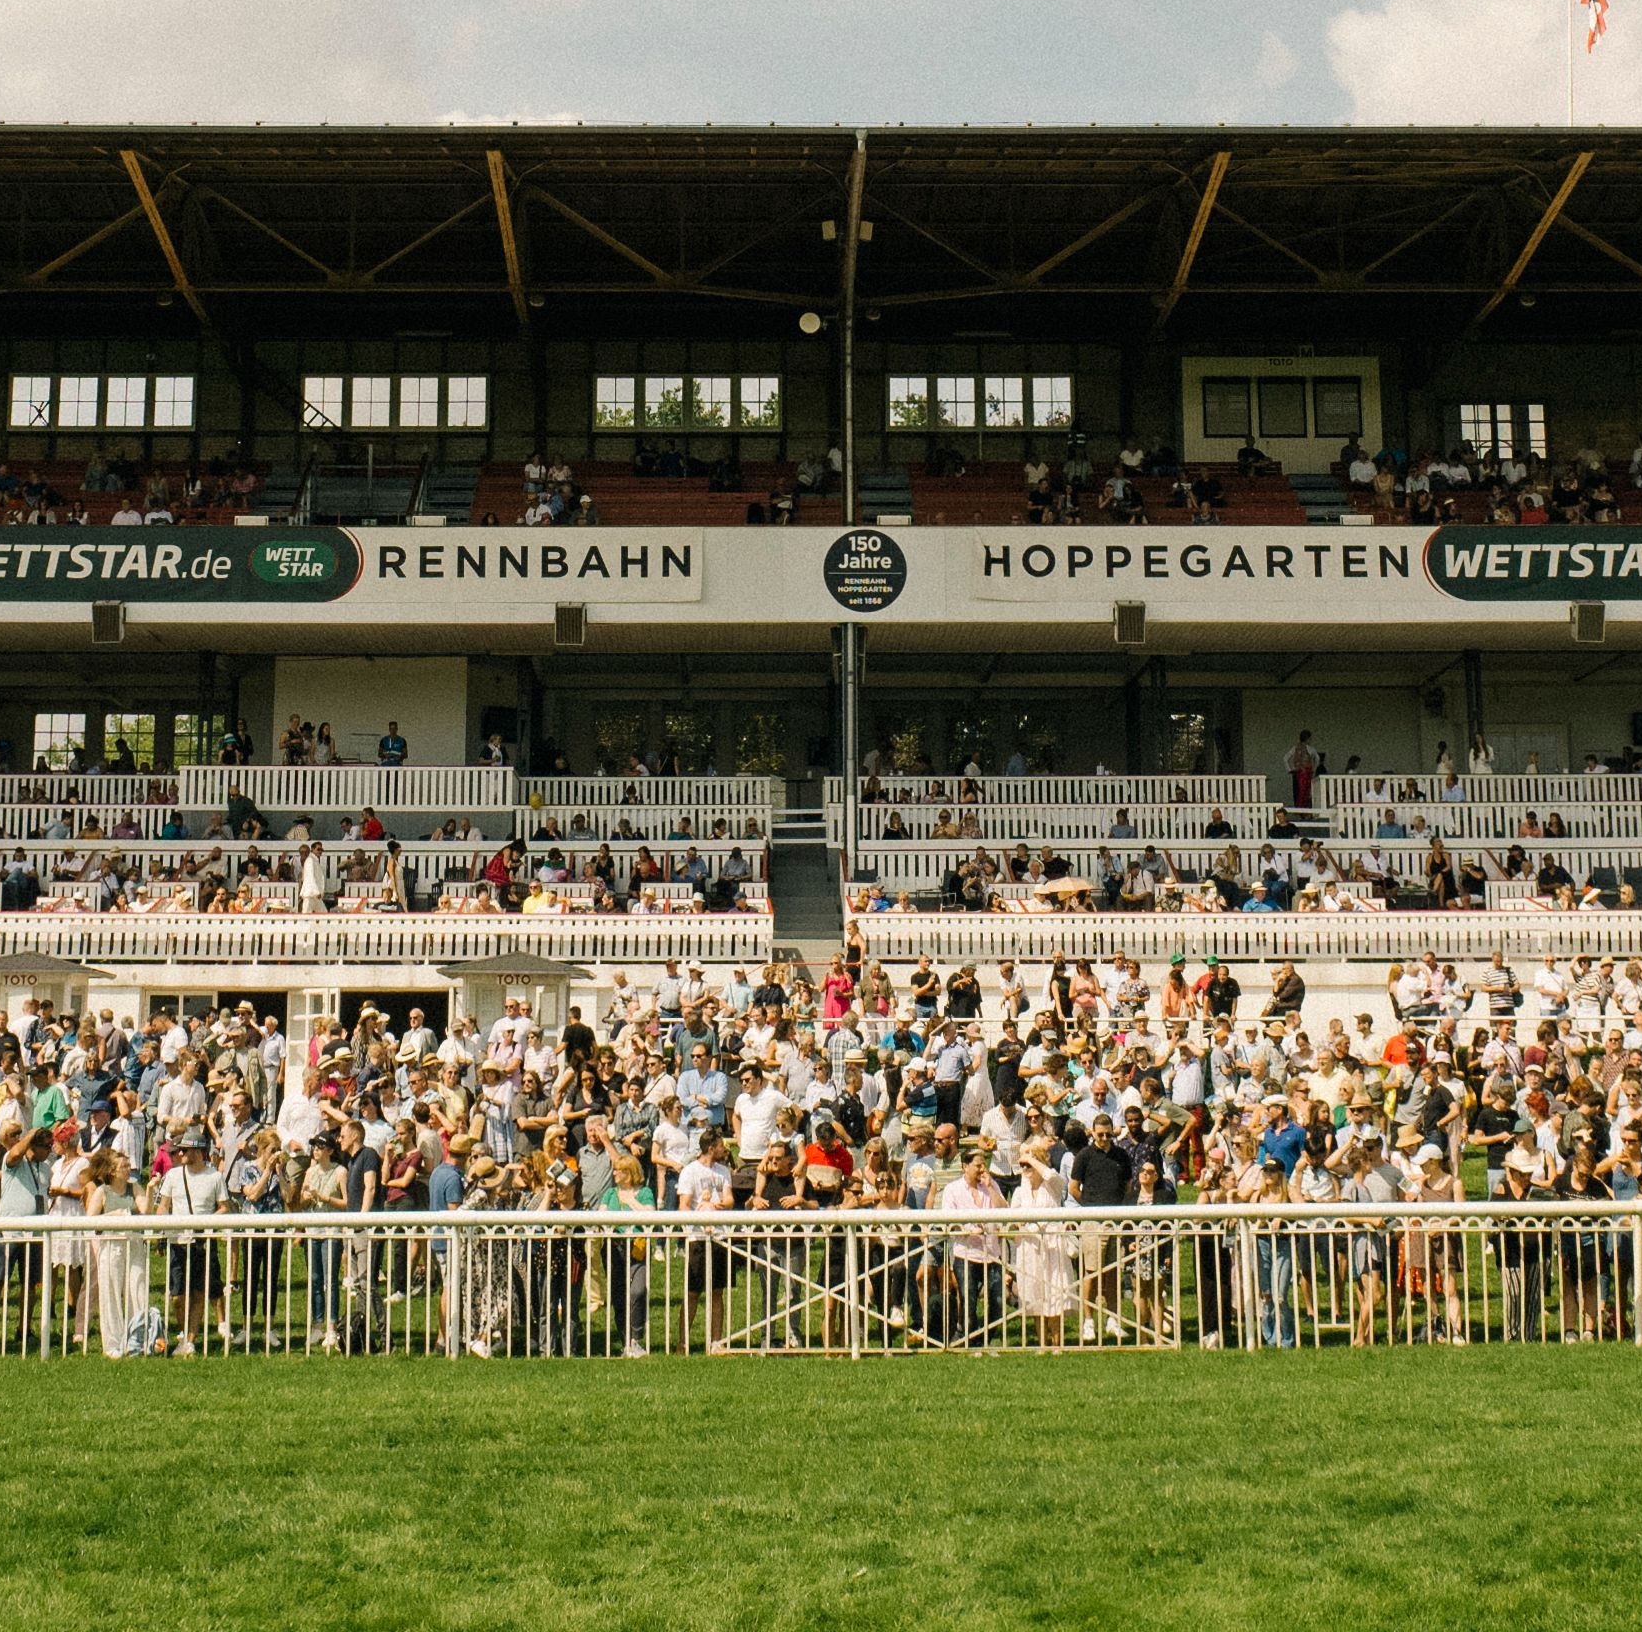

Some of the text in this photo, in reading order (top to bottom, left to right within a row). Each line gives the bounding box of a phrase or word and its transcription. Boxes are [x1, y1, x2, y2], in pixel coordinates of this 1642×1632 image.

[848, 536, 882, 551] 150
[265, 547, 316, 562] WETT
[378, 545, 692, 579] RENNBAHN
[838, 553, 892, 569] Jahre
[983, 544, 1409, 578] HOPPEGARTEN
[277, 562, 324, 577] STAR
[844, 577, 887, 585] RENNBAHN
[837, 585, 893, 593] HOPPEGARTEN
[848, 597, 863, 605] seit
[4, 974, 38, 985] TOTO
[497, 974, 532, 985] TOTO
